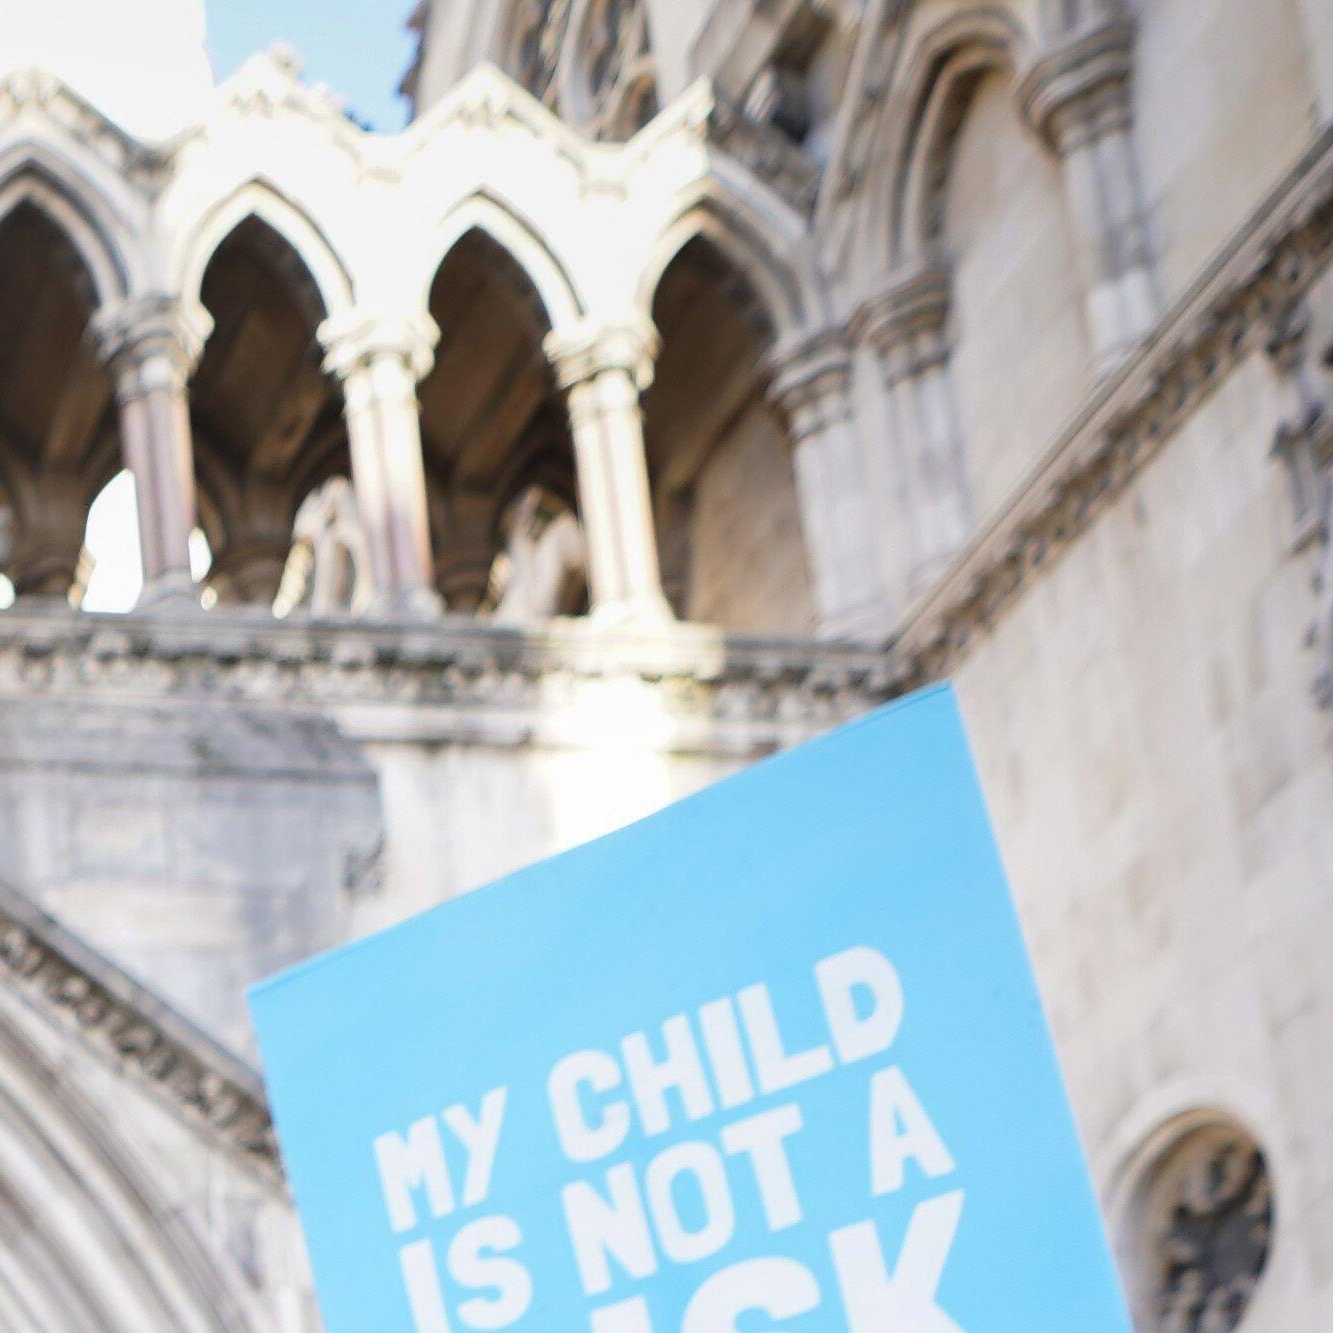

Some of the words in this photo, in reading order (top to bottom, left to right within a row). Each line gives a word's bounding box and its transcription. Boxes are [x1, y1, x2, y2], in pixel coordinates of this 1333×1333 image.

[373, 1085, 507, 1235] MY
[547, 945, 904, 1163] CHILD
[561, 1102, 803, 1296] NOT
[868, 1063, 955, 1198] A
